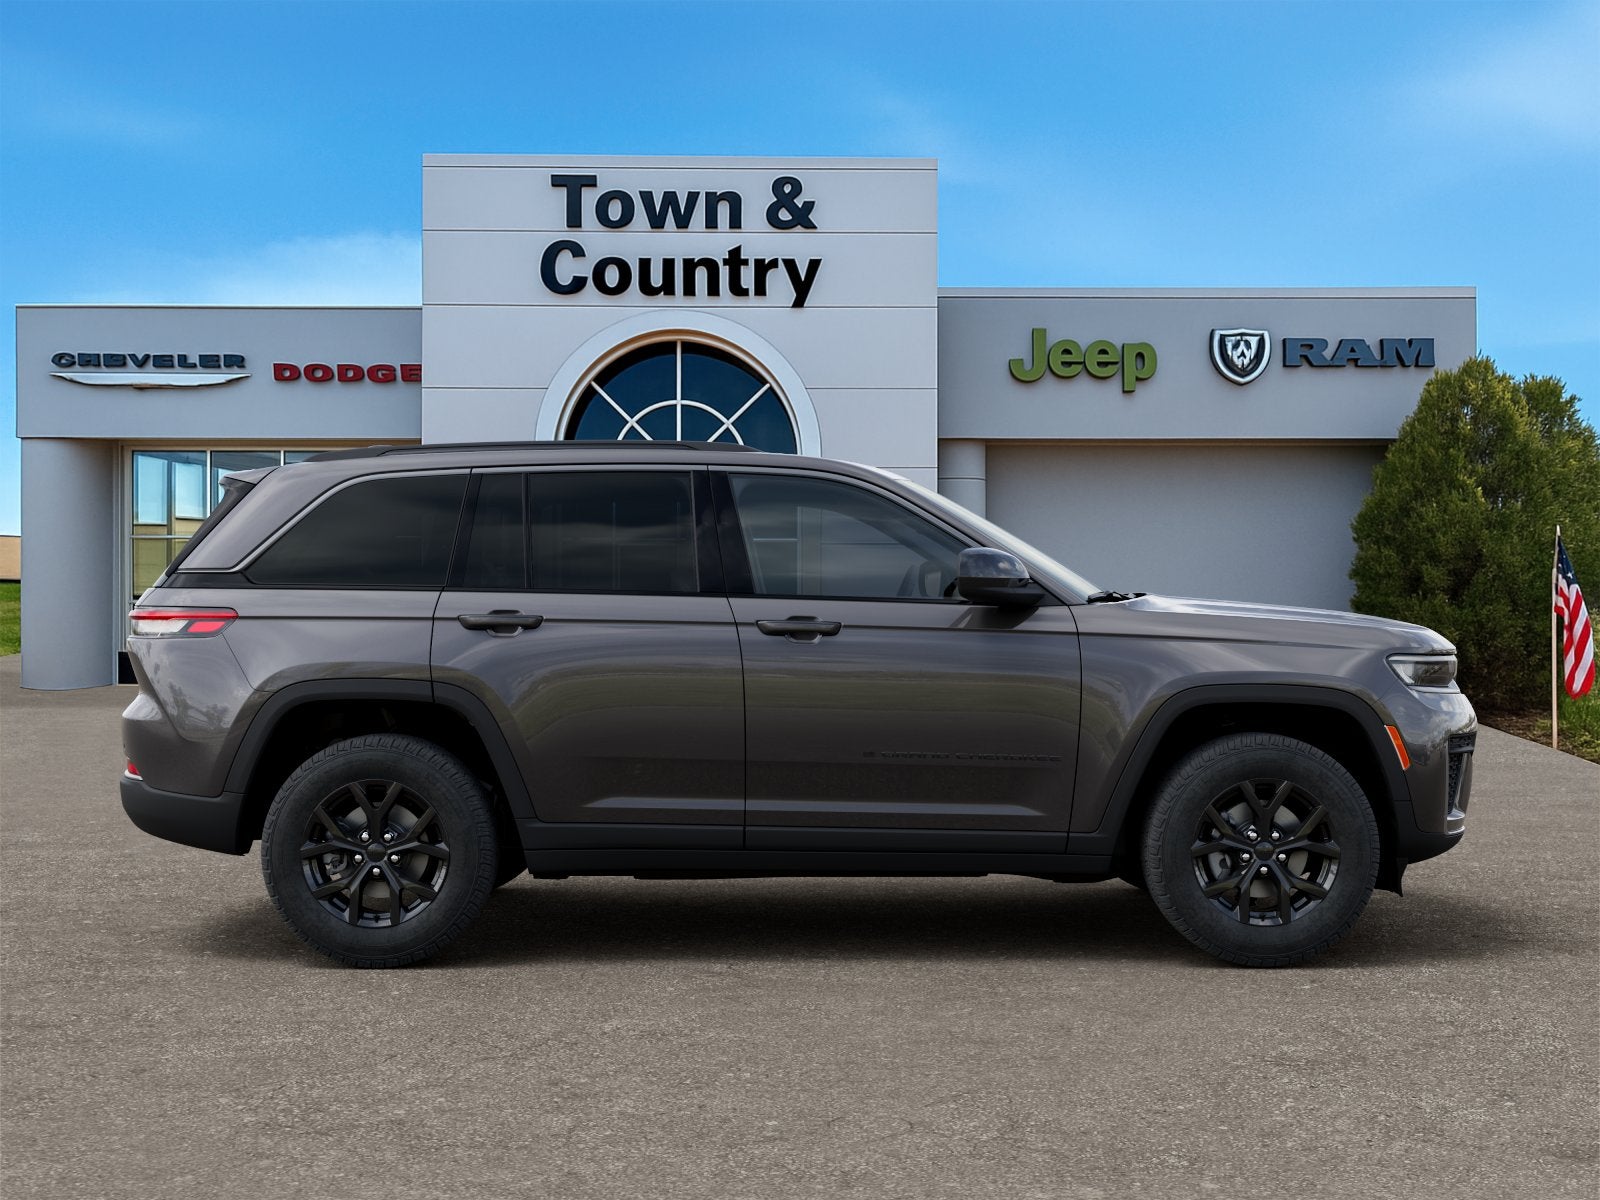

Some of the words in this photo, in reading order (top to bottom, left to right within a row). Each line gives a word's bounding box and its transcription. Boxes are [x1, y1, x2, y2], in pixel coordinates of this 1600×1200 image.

[550, 174, 742, 229] Town
[765, 175, 818, 230] &
[540, 239, 822, 308] Country
[273, 362, 422, 384] DODGE
[1009, 328, 1158, 393] Jeep
[1283, 337, 1435, 368] RAM
